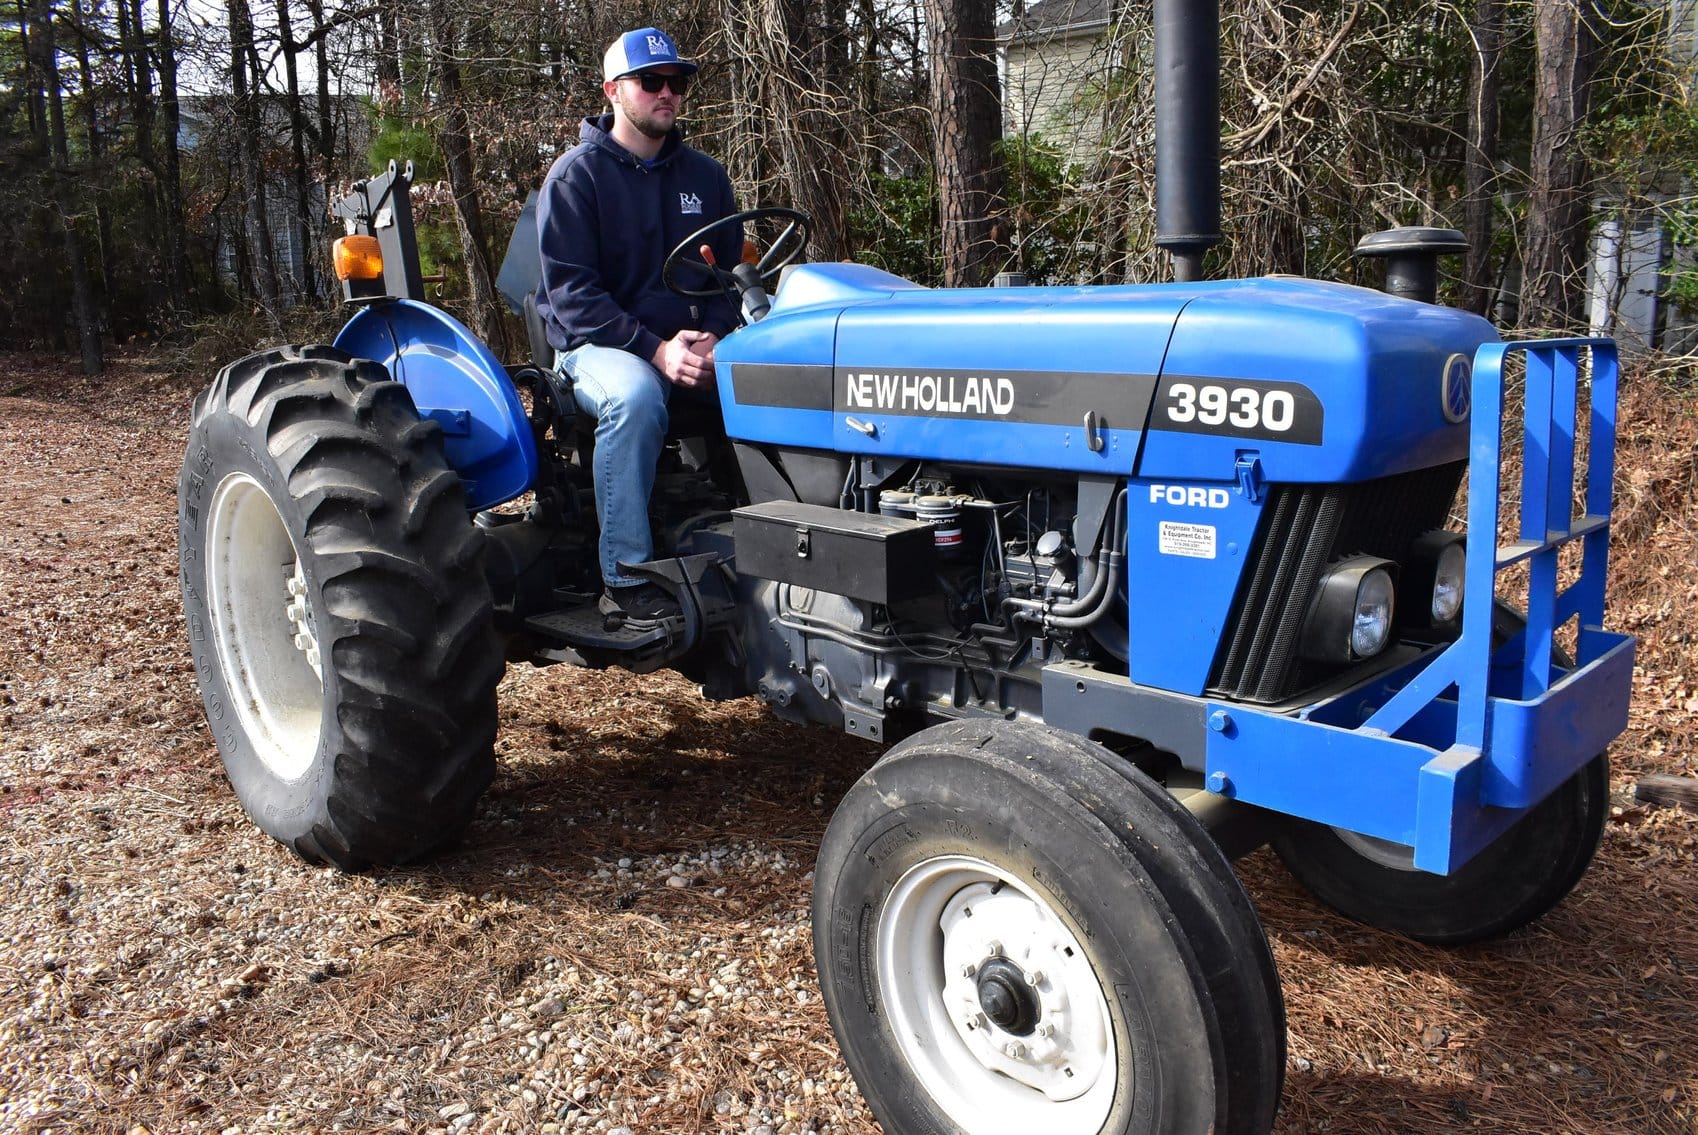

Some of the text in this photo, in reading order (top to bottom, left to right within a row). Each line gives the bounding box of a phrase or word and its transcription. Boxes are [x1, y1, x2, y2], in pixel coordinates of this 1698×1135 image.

[646, 35, 666, 47] RA
[679, 192, 703, 205] RA
[847, 373, 1015, 415] NEW HOLLAND
[1167, 383, 1295, 432] 3930
[1150, 484, 1229, 508] FORD
